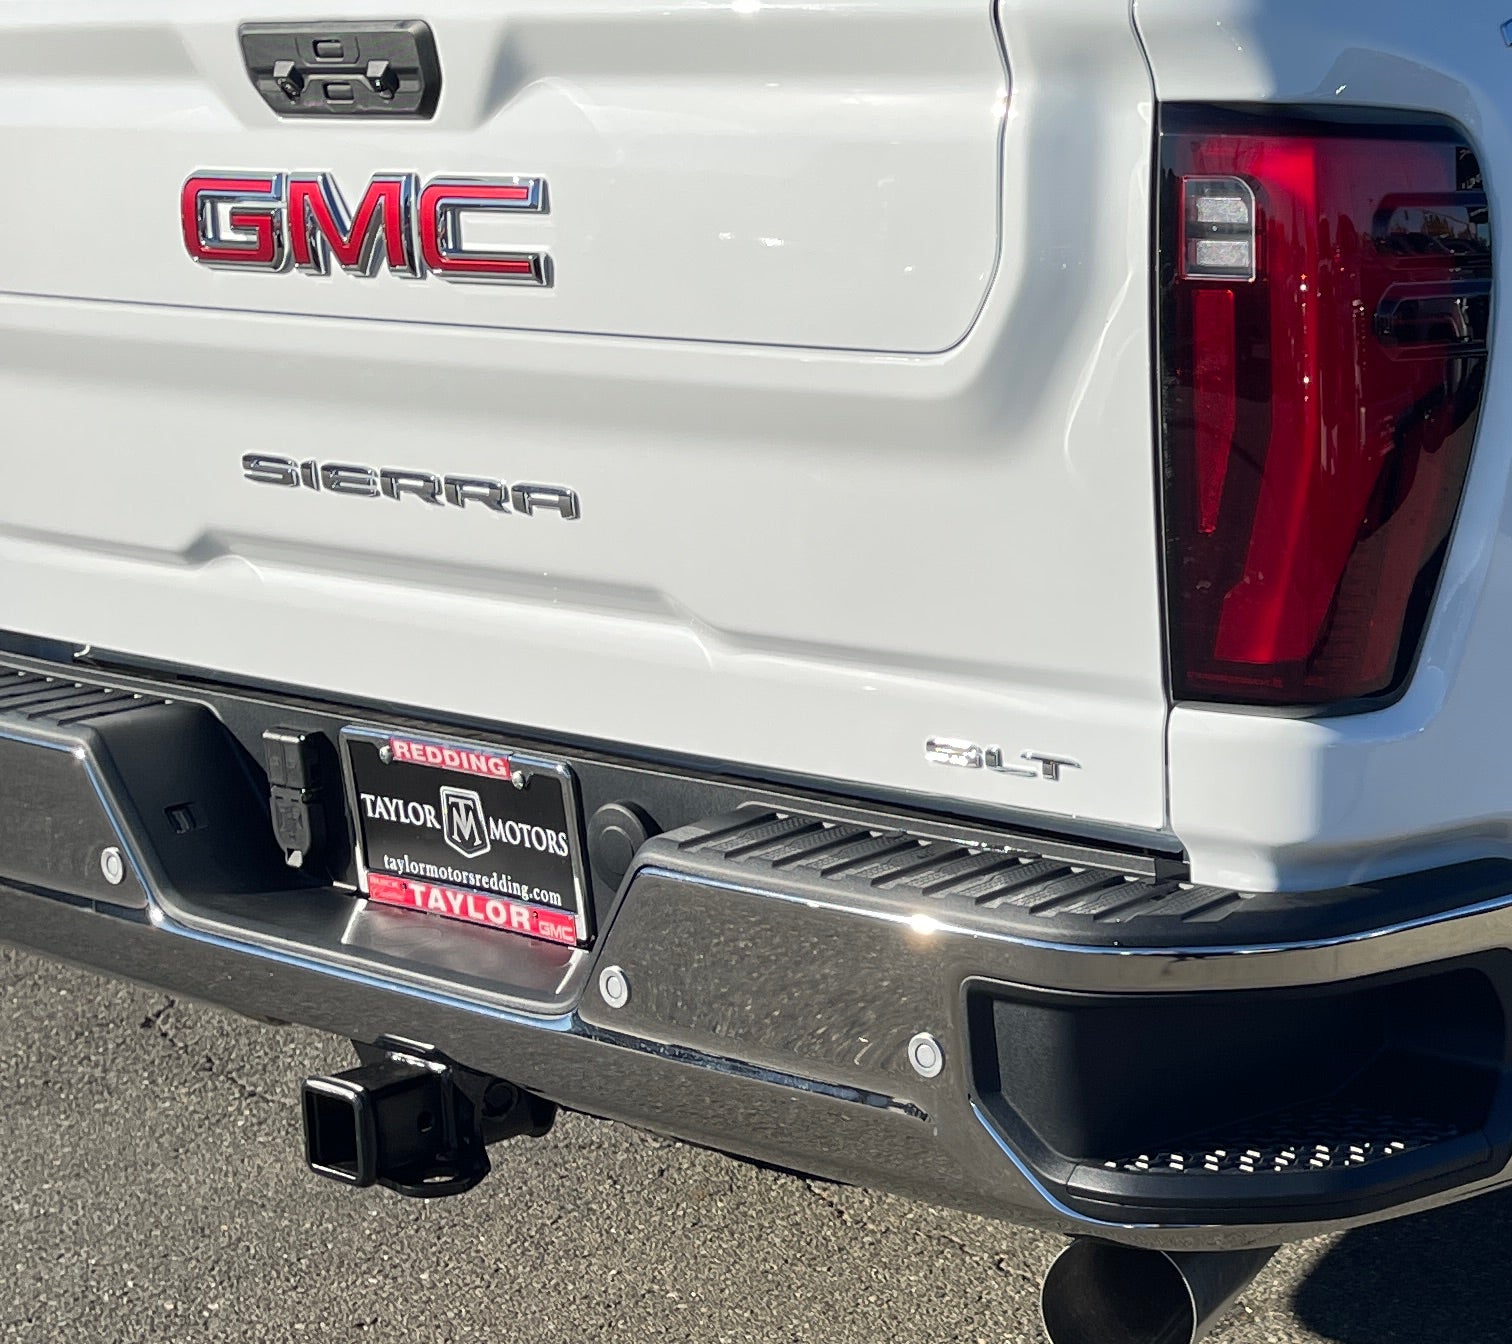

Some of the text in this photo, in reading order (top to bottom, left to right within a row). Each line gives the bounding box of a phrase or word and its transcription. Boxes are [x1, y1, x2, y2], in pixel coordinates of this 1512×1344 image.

[181, 169, 555, 288] GMC
[242, 453, 581, 521] SIERRA
[393, 740, 507, 777] REDDING
[925, 736, 1081, 782] SLT
[361, 792, 441, 829] TAYLOR
[489, 816, 569, 857] MOTORS
[384, 854, 562, 907] taylormotorsredding.com
[408, 884, 531, 931] TAYLOR
[538, 921, 575, 942] GMC
